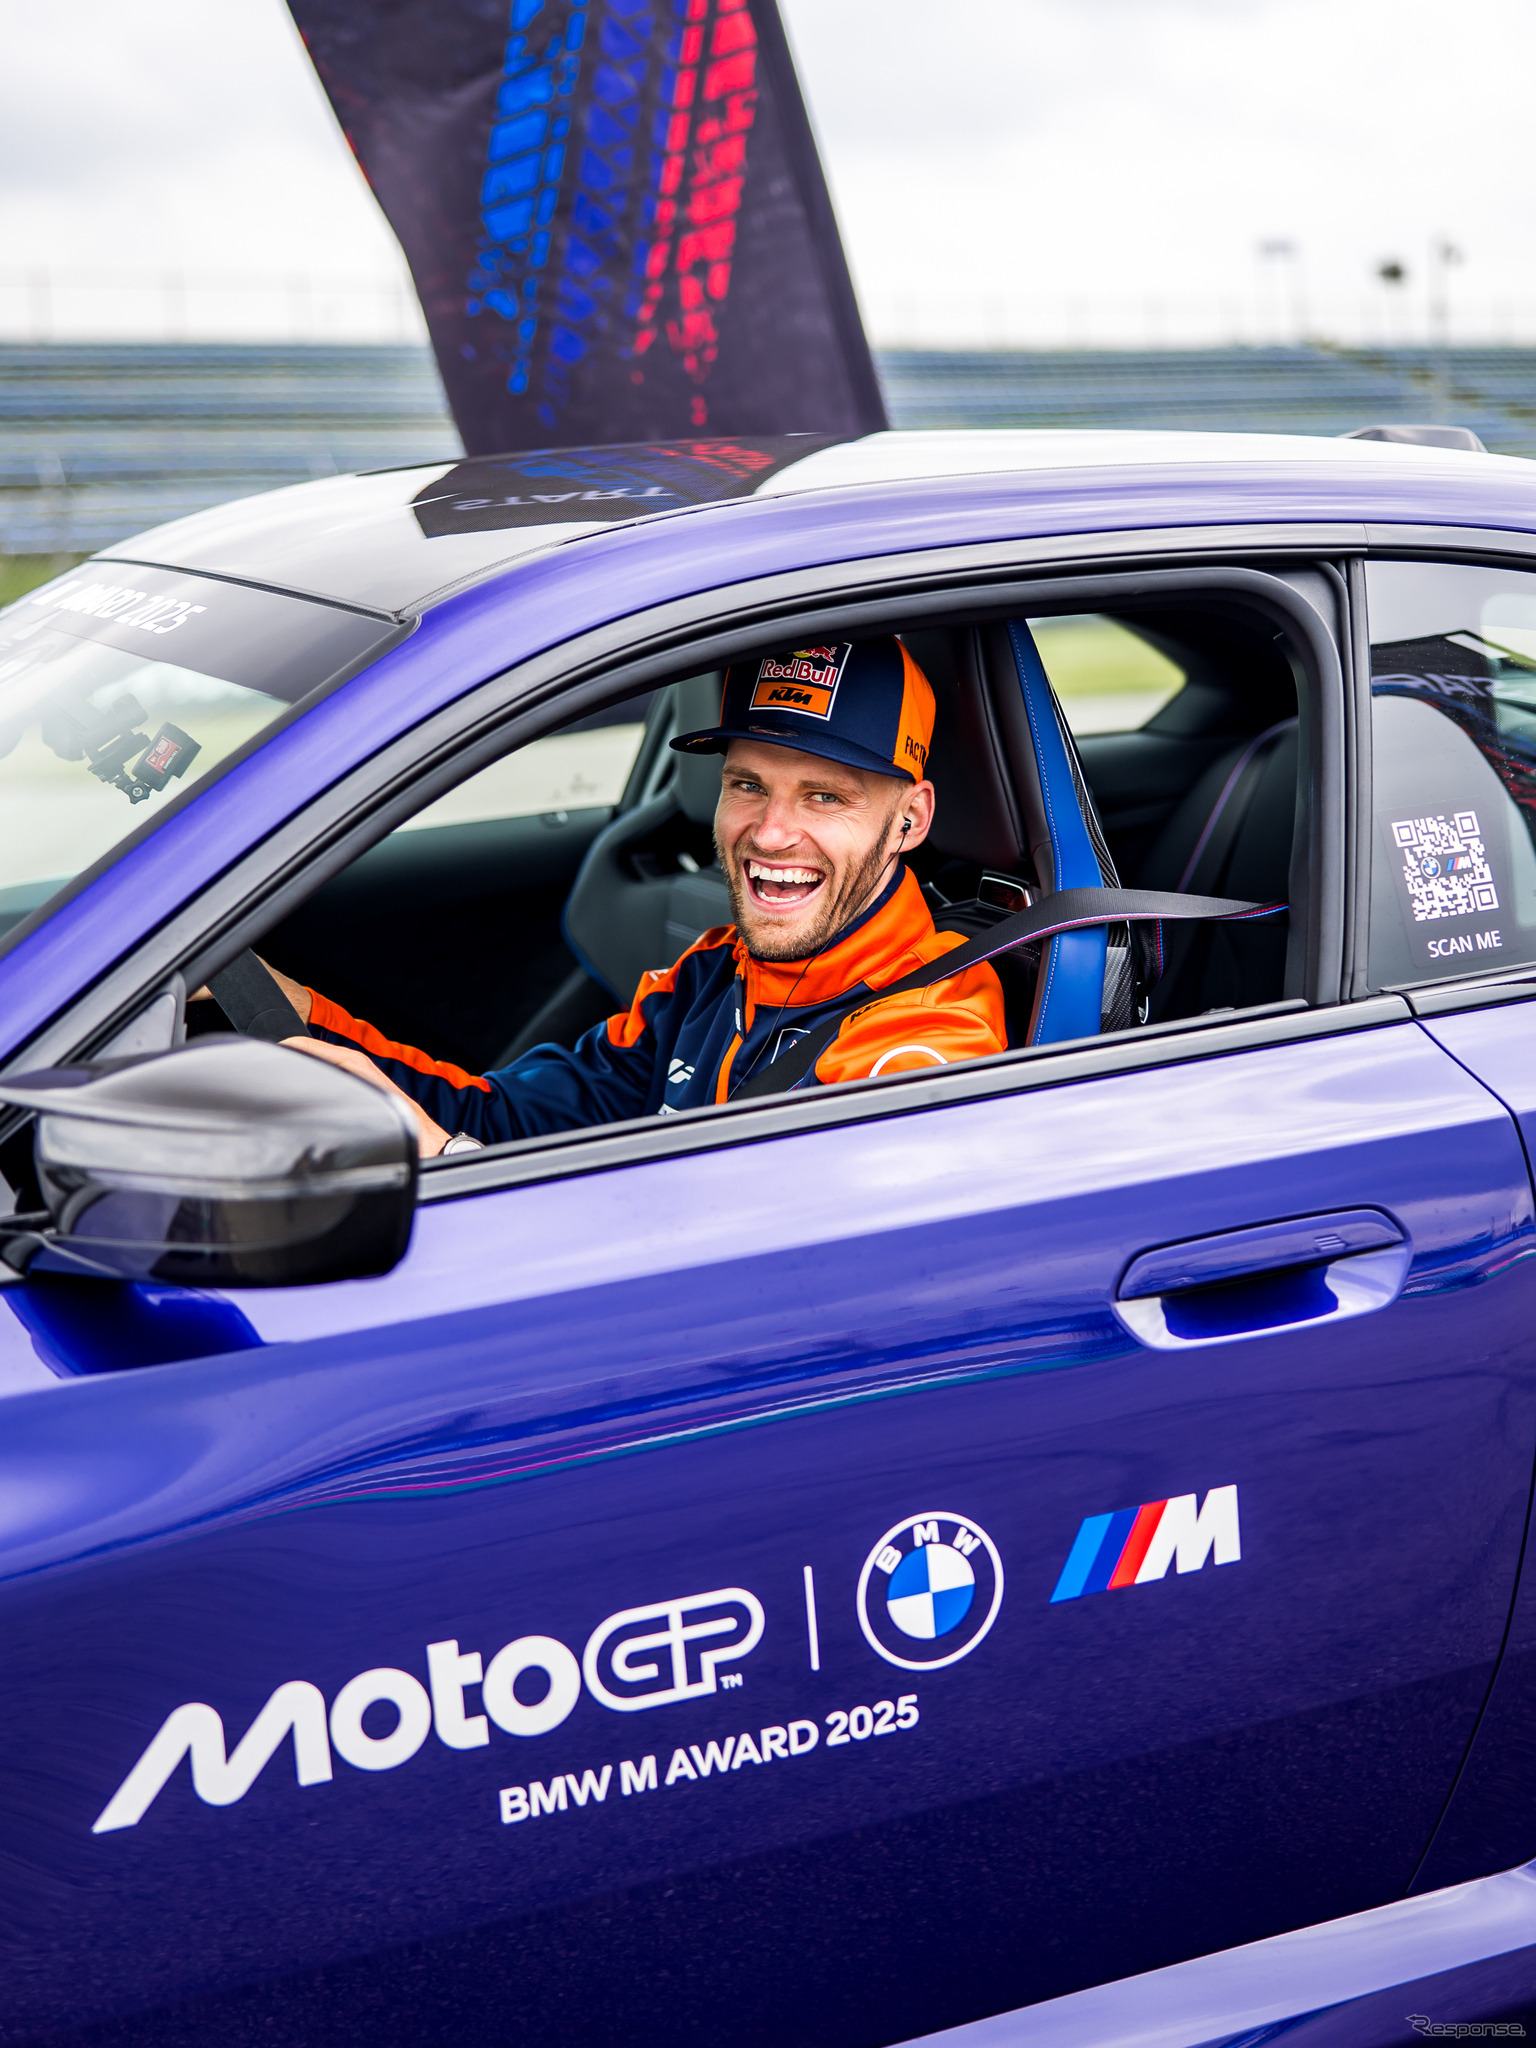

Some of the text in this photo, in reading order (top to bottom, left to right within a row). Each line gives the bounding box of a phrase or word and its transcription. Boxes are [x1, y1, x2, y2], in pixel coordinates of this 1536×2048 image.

[113, 595, 208, 635] 2025
[761, 659, 839, 688] Red Bull
[767, 686, 813, 706] KTM
[1427, 929, 1503, 959] SCAN ME
[874, 1519, 982, 1575] BMW
[499, 1694, 919, 1824] BMW M AWARD 2025
